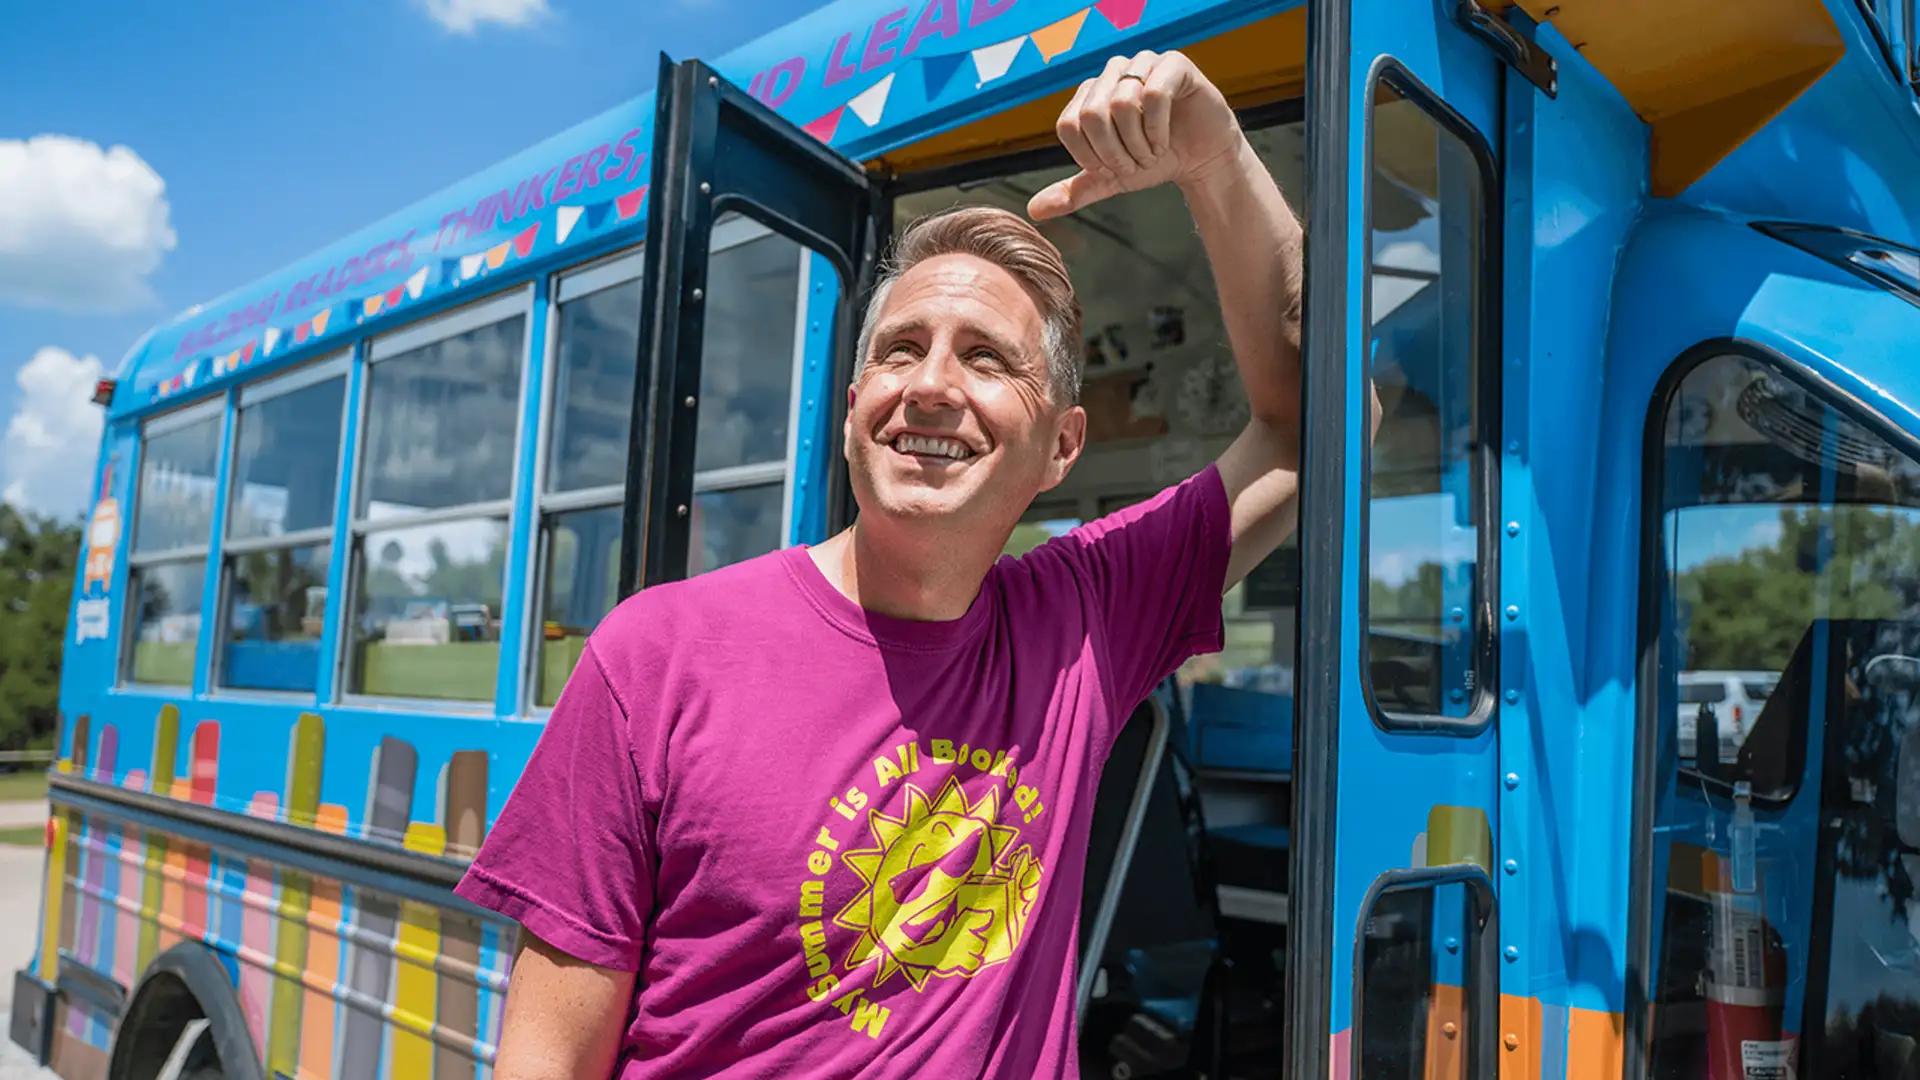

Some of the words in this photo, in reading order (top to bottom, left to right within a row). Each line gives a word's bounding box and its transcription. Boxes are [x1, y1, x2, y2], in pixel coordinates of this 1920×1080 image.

[433, 127, 647, 252] THINKERS,
[873, 741, 920, 787] All
[830, 786, 868, 821] is
[800, 826, 840, 1002] Summer
[832, 988, 891, 1039] My
